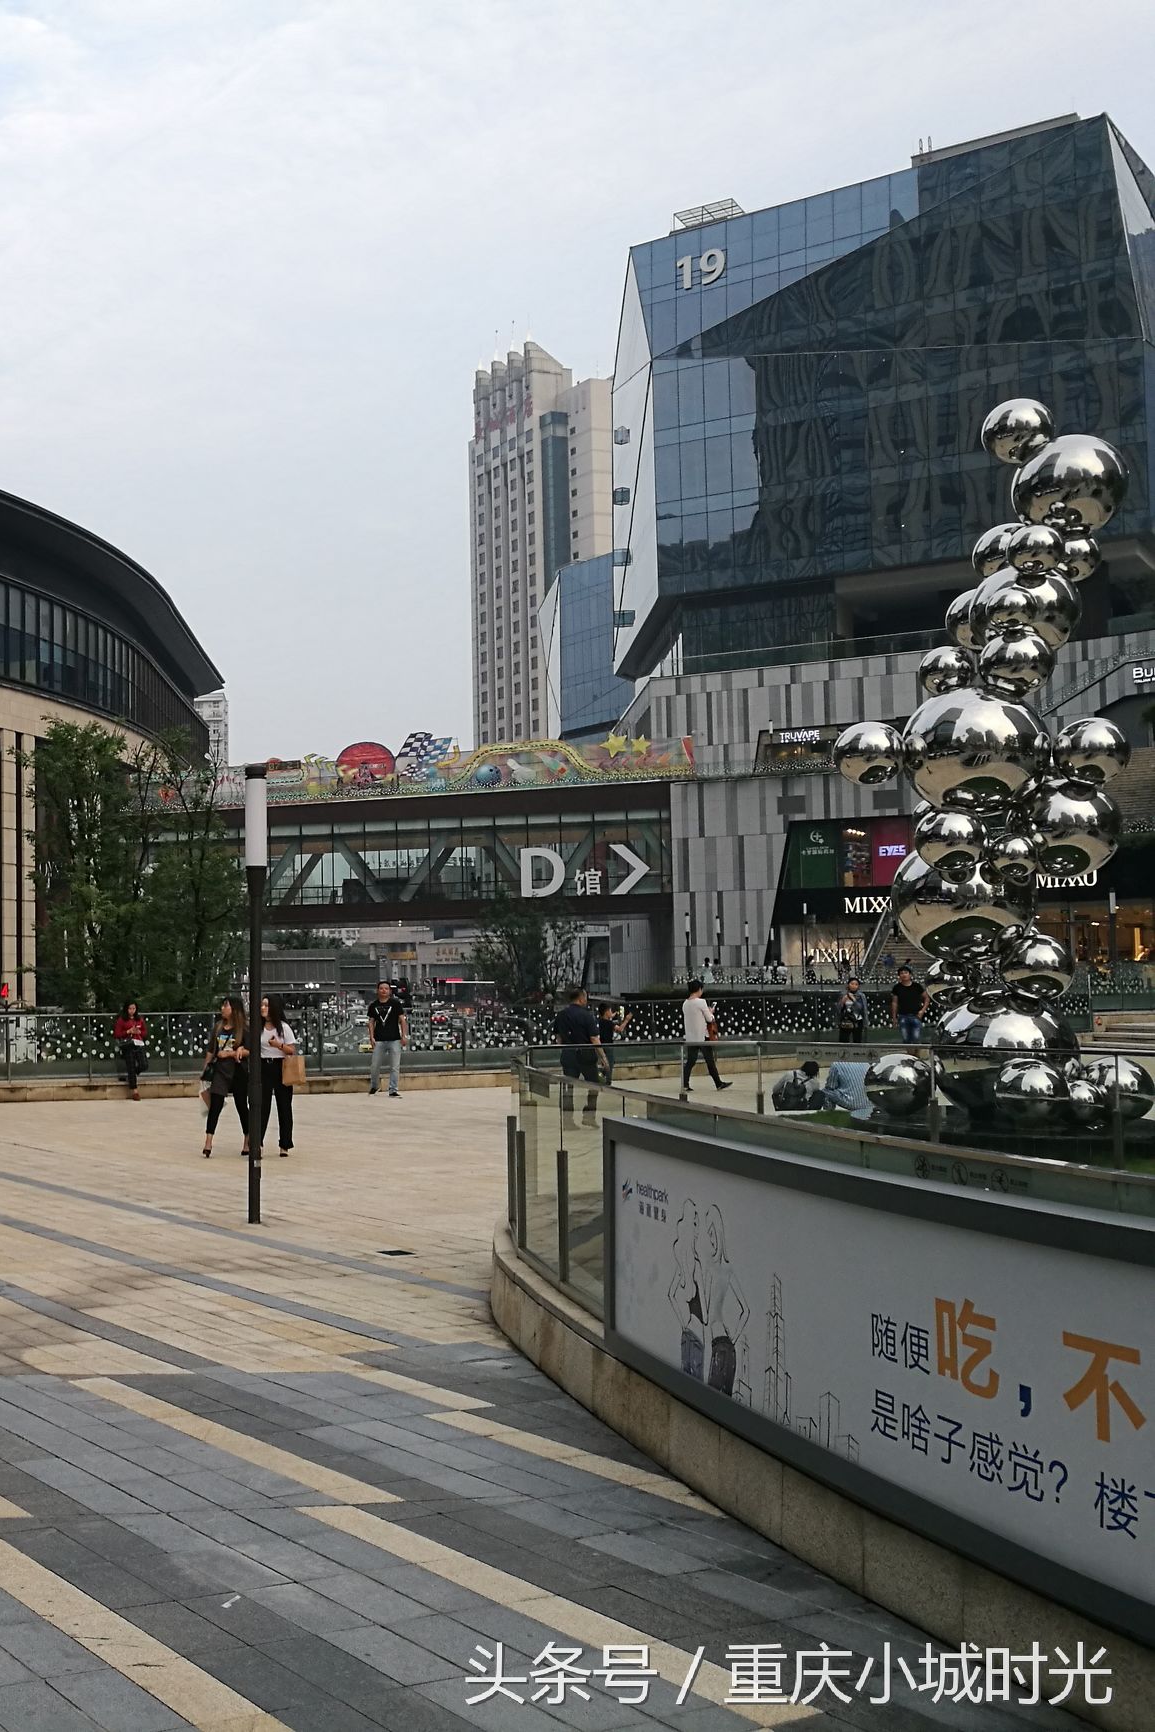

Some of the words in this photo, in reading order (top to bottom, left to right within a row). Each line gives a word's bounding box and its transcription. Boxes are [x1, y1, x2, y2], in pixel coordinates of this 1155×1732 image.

[677, 249, 726, 290] 19
[779, 729, 820, 740] TRUVAPE
[878, 844, 906, 857] EYES
[636, 1179, 669, 1205] healthpark
